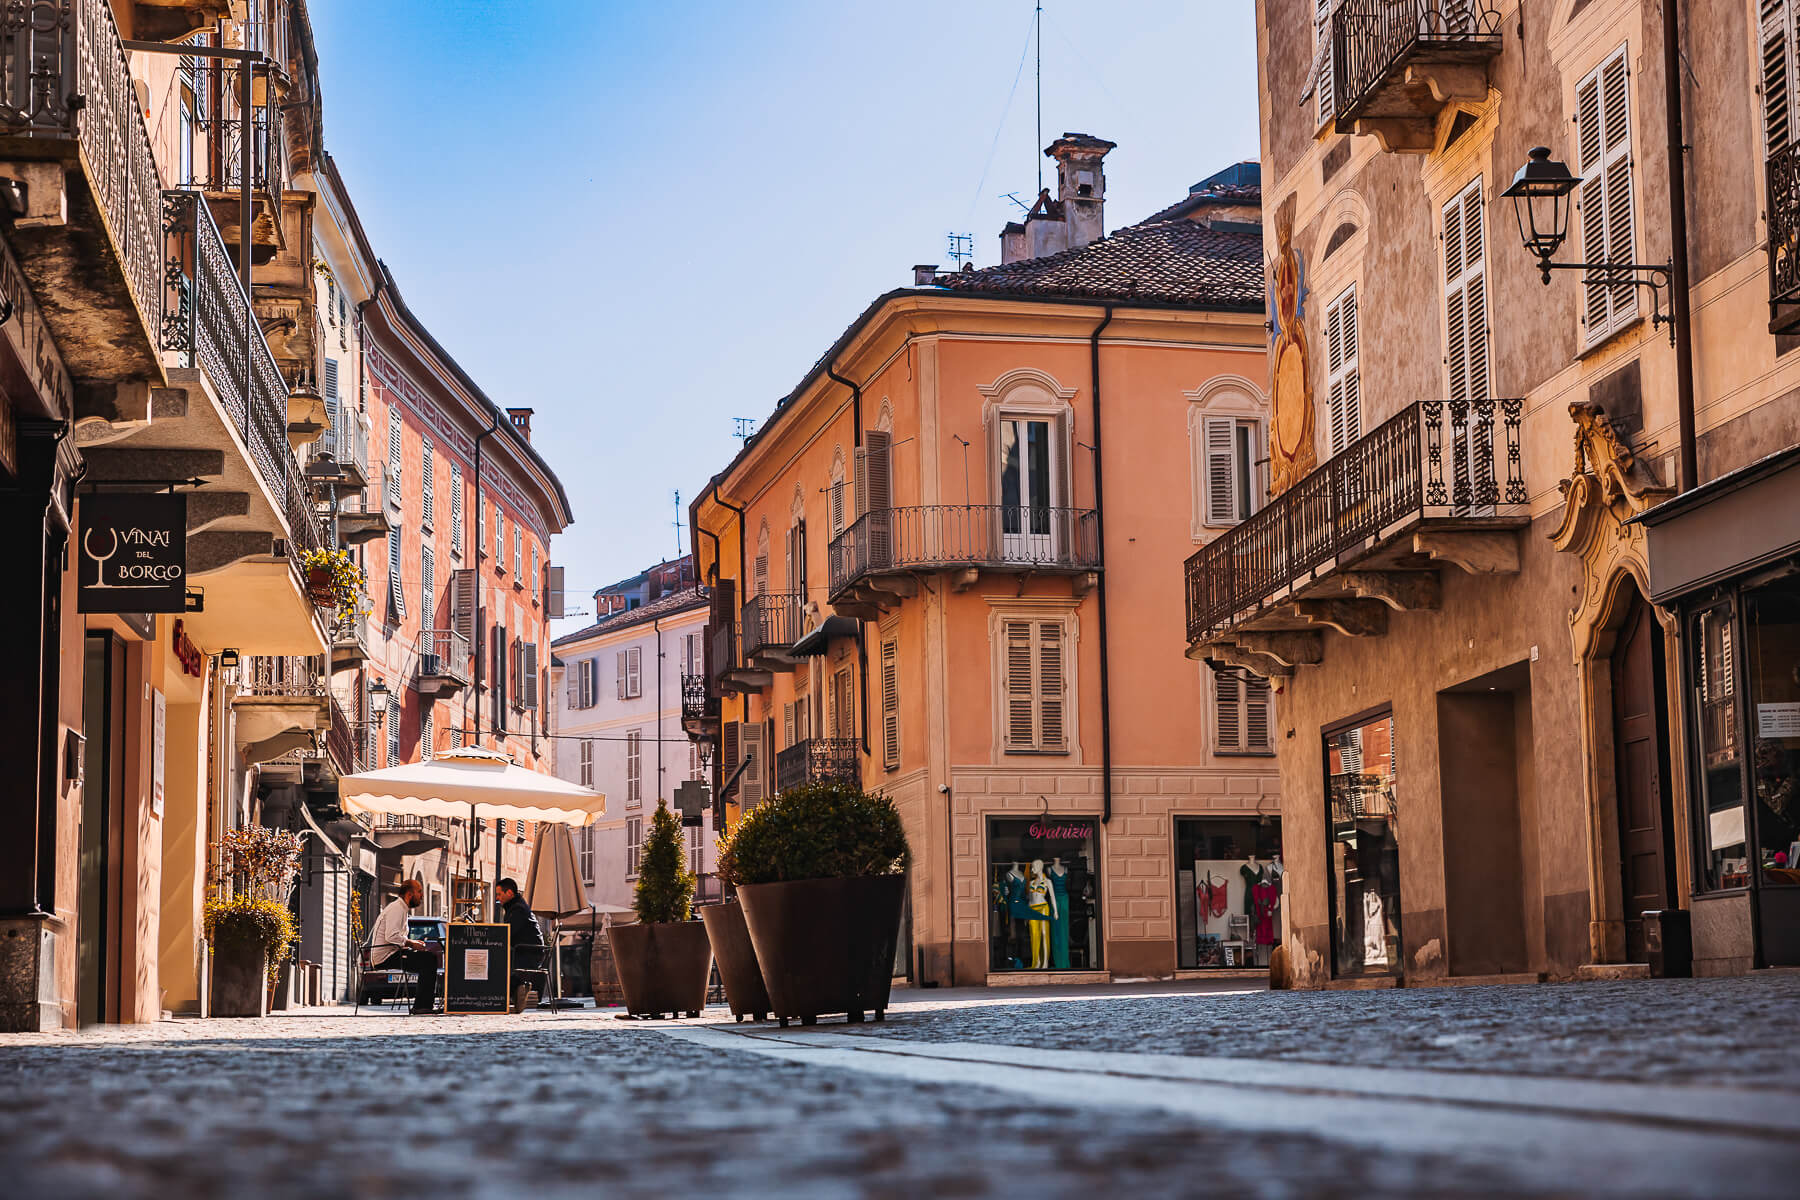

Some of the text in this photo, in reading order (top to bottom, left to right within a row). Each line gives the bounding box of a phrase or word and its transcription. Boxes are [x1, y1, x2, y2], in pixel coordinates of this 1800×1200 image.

[120, 528, 171, 547] VINAI
[136, 551, 154, 559] DEL
[118, 565, 182, 581] BORGO
[1029, 822, 1093, 839] Patrizia
